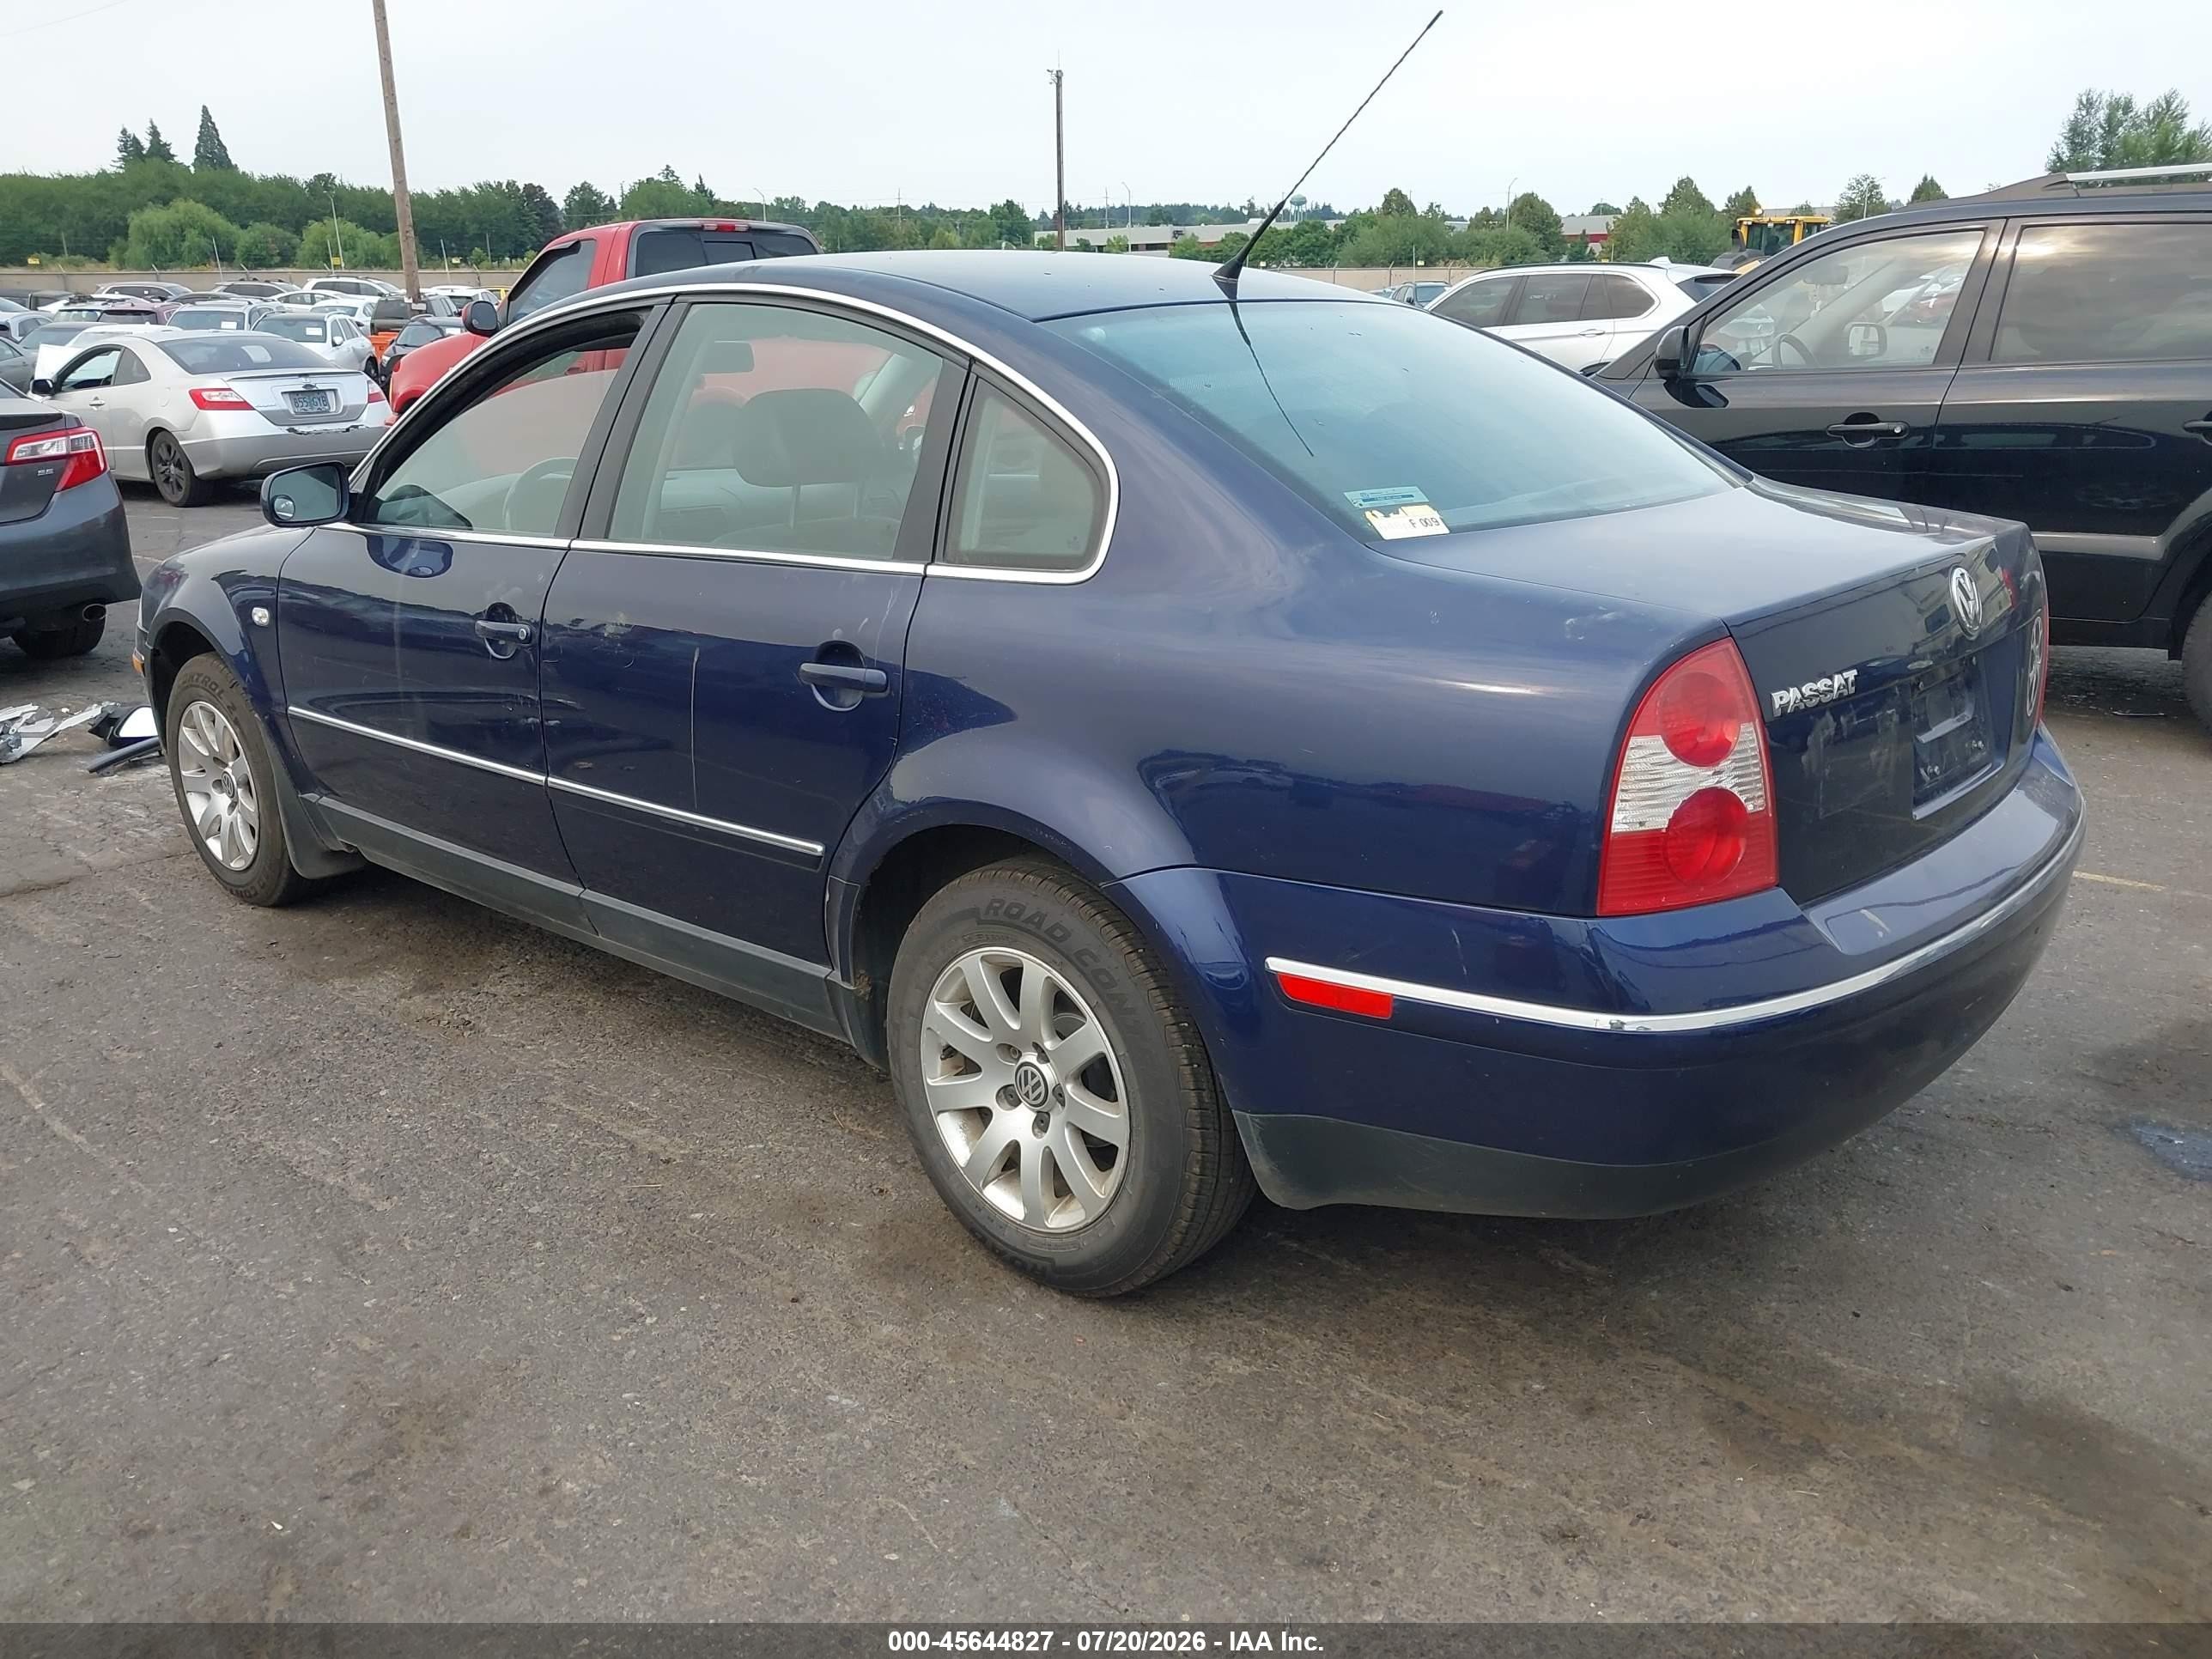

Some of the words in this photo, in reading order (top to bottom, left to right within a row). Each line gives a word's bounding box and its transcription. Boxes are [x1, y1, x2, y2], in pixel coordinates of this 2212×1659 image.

[1419, 517, 1441, 527] 009
[1771, 669, 1858, 717] PASSAT
[984, 898, 1073, 944] ROAD
